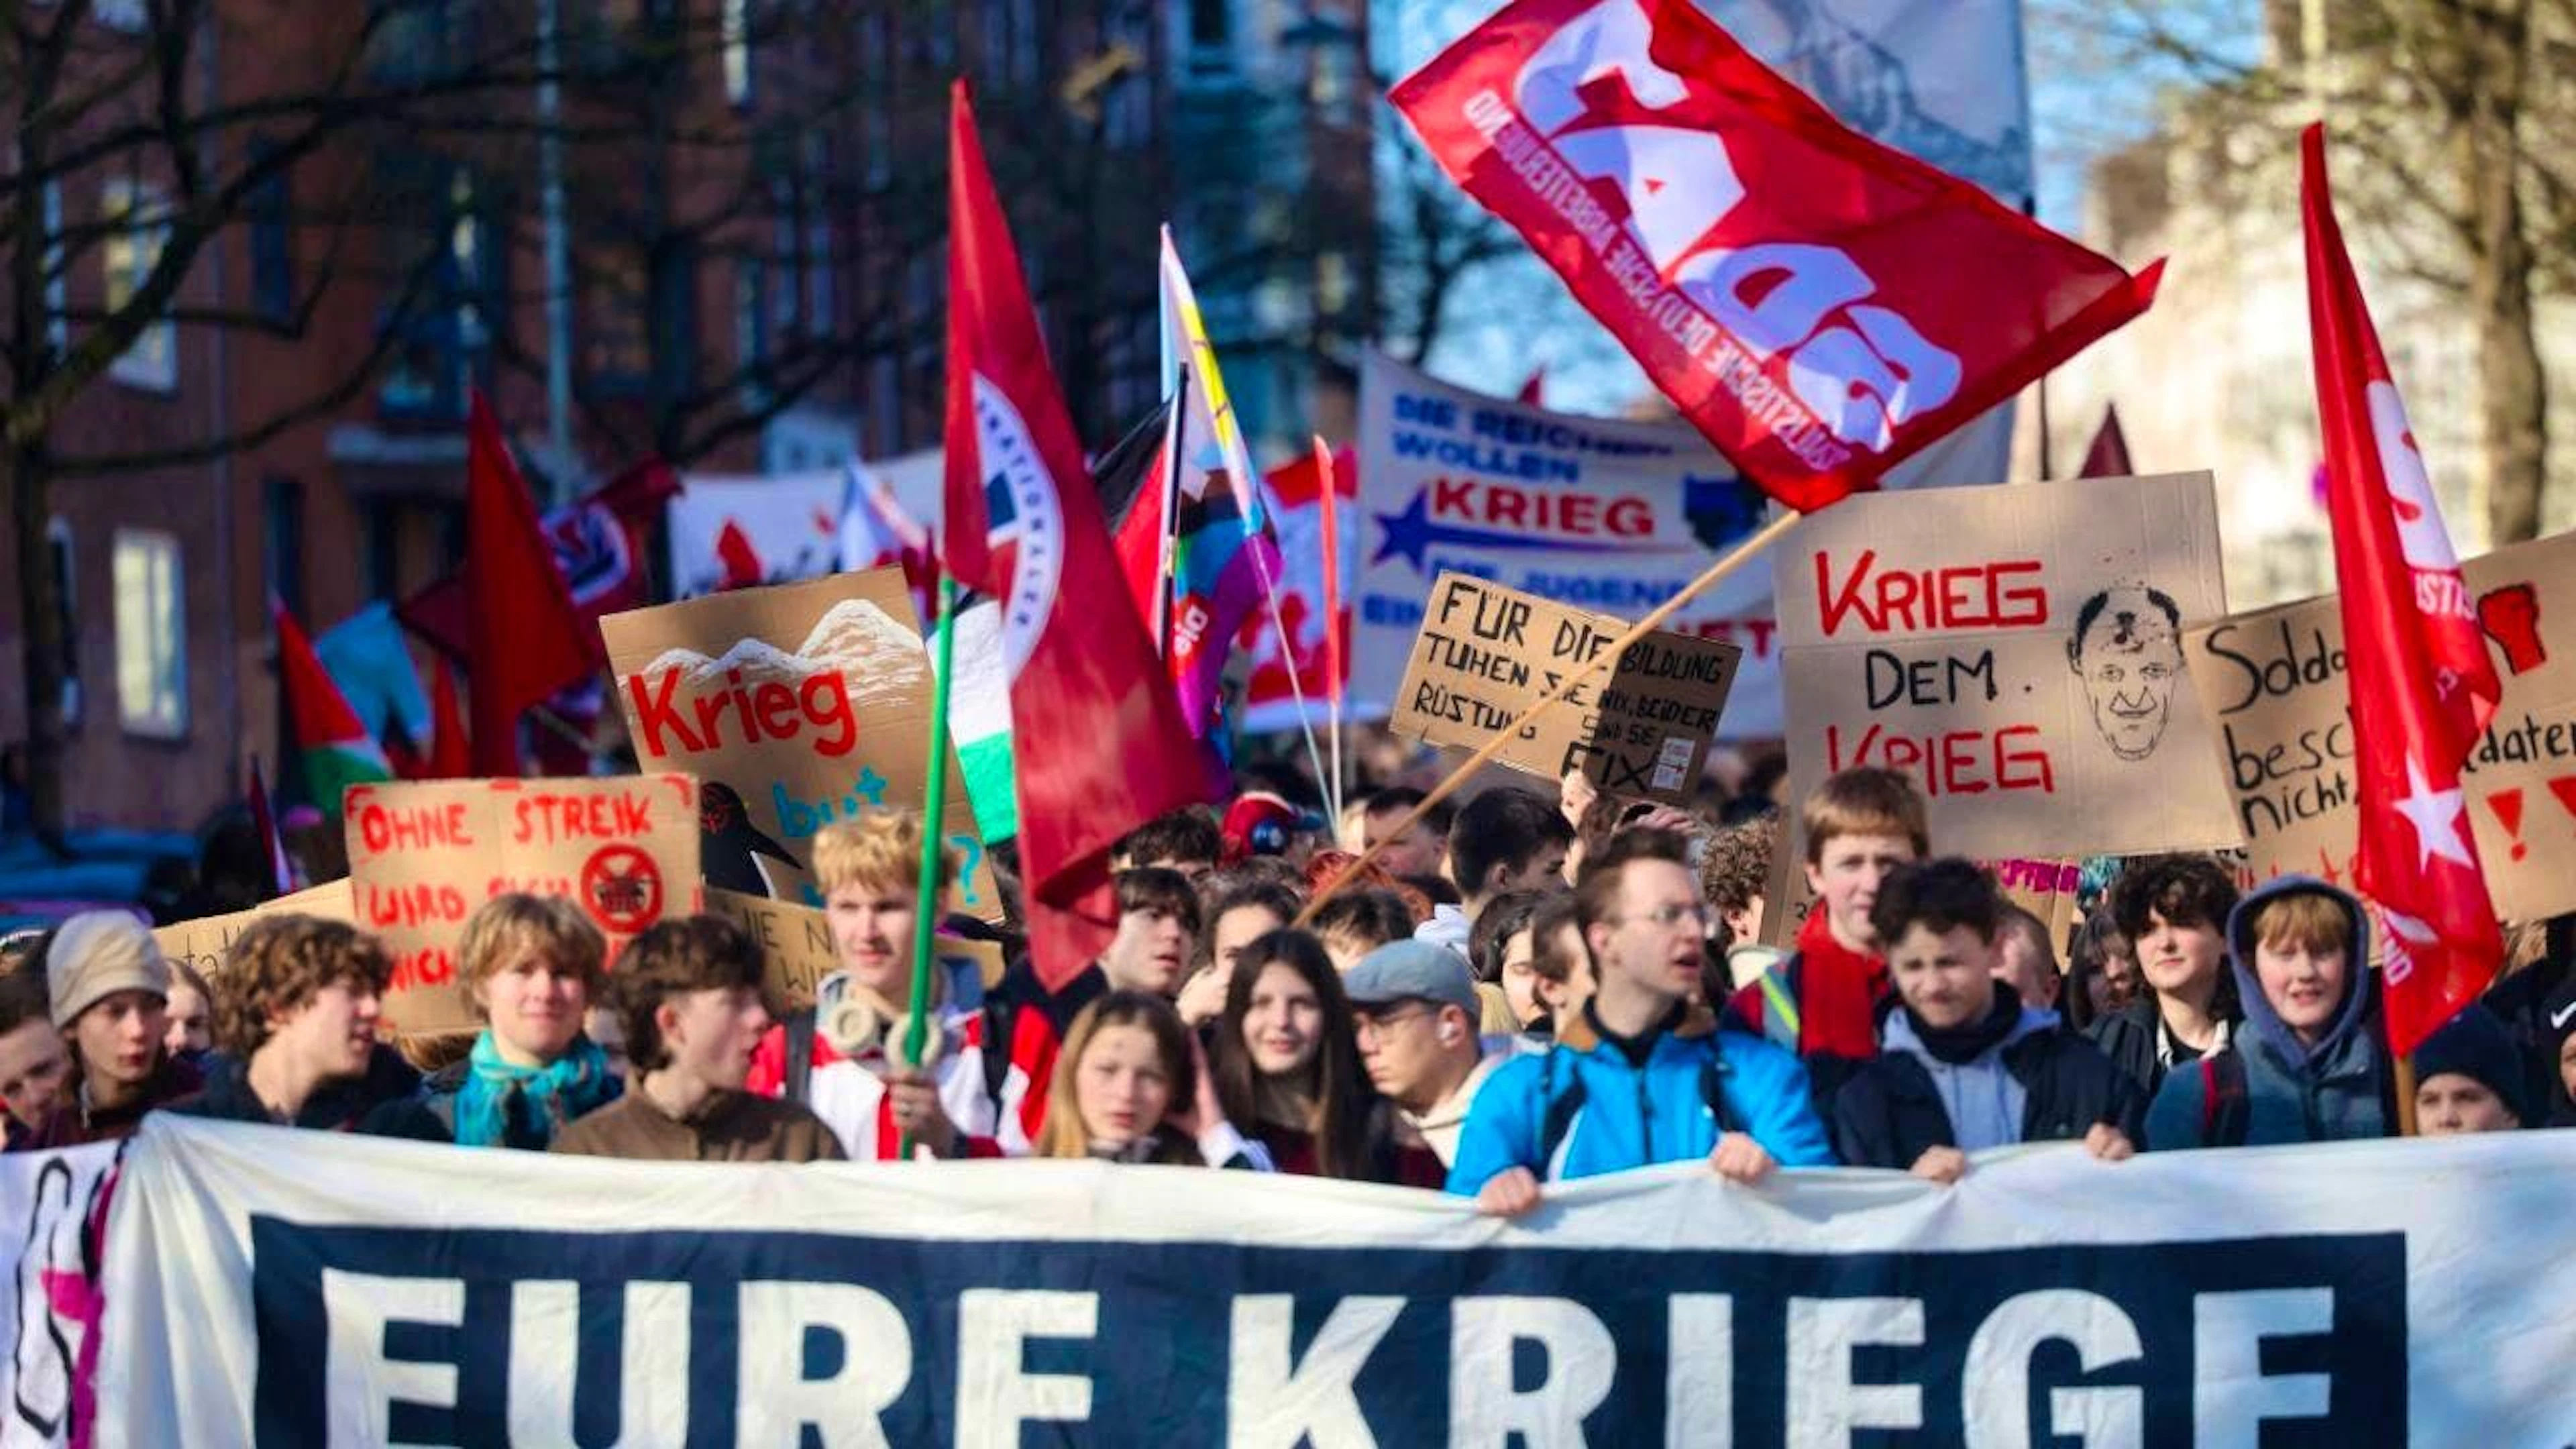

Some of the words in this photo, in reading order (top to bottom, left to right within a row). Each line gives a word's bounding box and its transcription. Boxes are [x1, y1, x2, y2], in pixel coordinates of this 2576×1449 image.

[1394, 433, 1578, 483] WOLLEN
[1436, 477, 1654, 535] KRIEG
[1815, 549, 2049, 637] KRIEG
[1424, 632, 1529, 688] TUHEN
[1540, 670, 1589, 706] SE
[1441, 581, 1532, 647] FÜR
[1553, 618, 1614, 671] DIE
[1621, 640, 1723, 684] BILDUNG
[629, 666, 857, 758] Krieg
[1865, 648, 1998, 710] DEM
[2222, 706, 2356, 791] besc
[360, 804, 474, 854] OHNE
[514, 790, 652, 844] STREIK
[369, 880, 466, 928] WIRD
[324, 1268, 1097, 1449] EURE
[1229, 1285, 2335, 1449] KRIEGE
